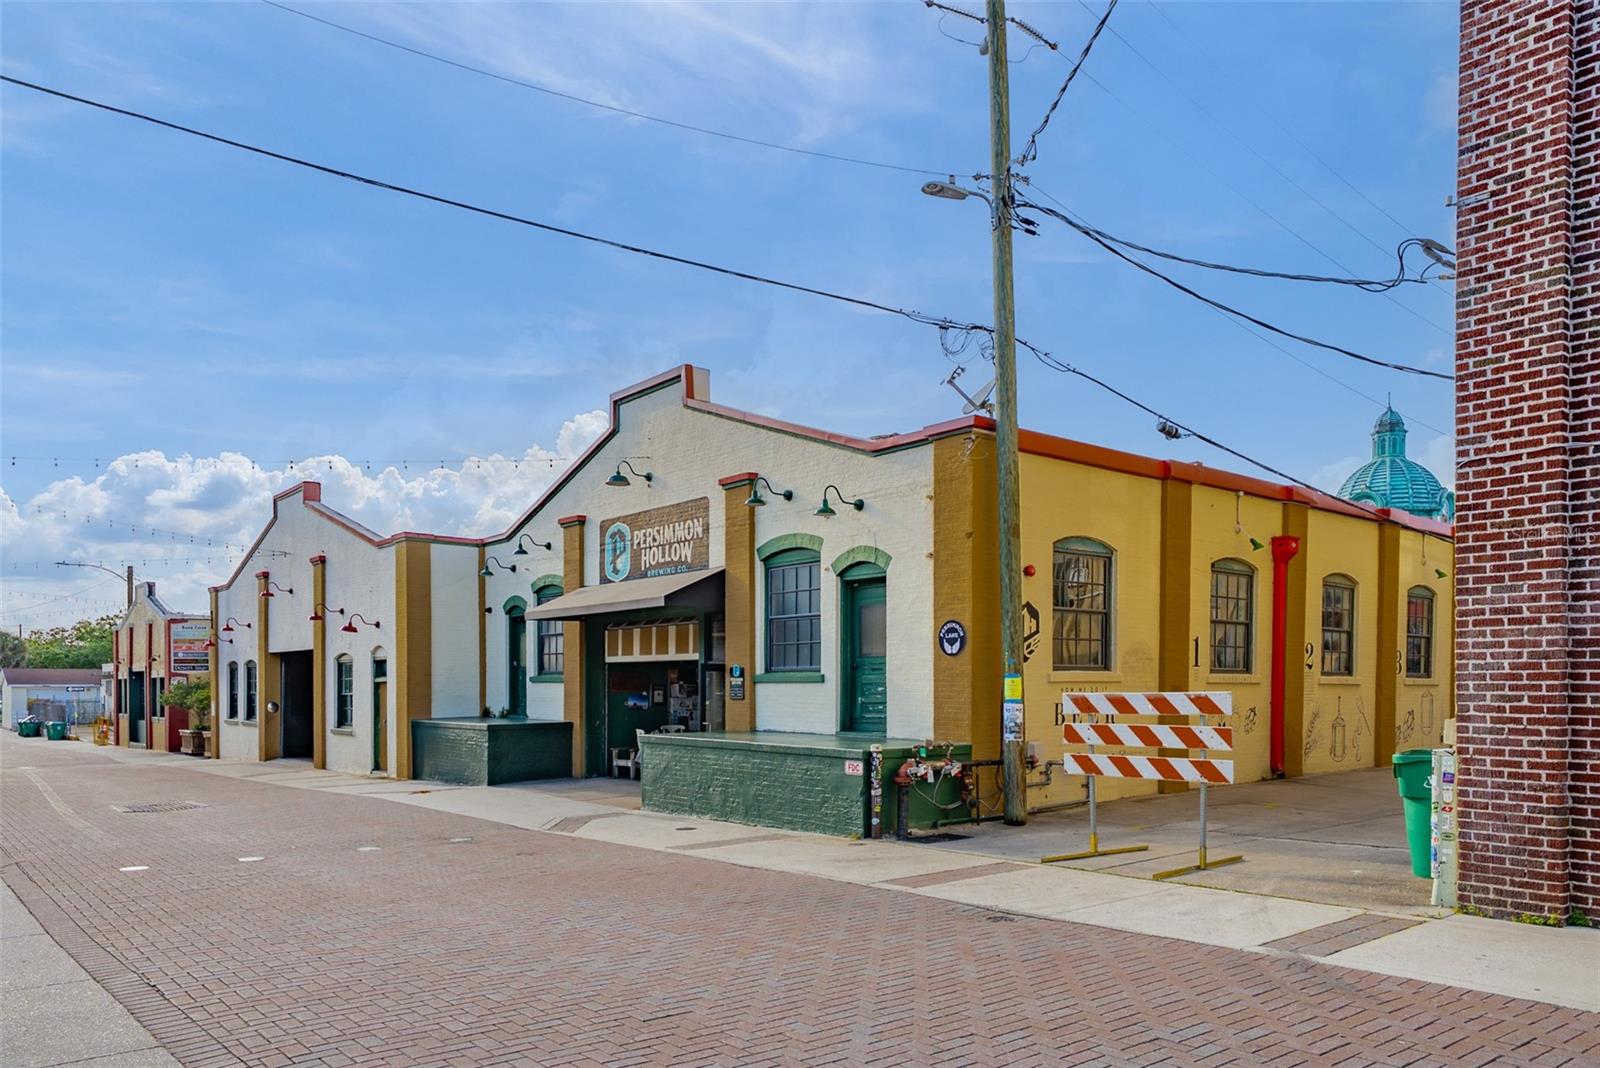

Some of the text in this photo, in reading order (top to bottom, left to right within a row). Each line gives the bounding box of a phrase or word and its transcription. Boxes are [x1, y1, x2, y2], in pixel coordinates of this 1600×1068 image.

[633, 517, 703, 550] PERSIMMON
[641, 541, 693, 571] HOLLOW
[647, 566, 675, 577] BREWING
[1193, 635, 1201, 668] 1
[1305, 642, 1314, 670] 2
[847, 763, 860, 773] FDC
